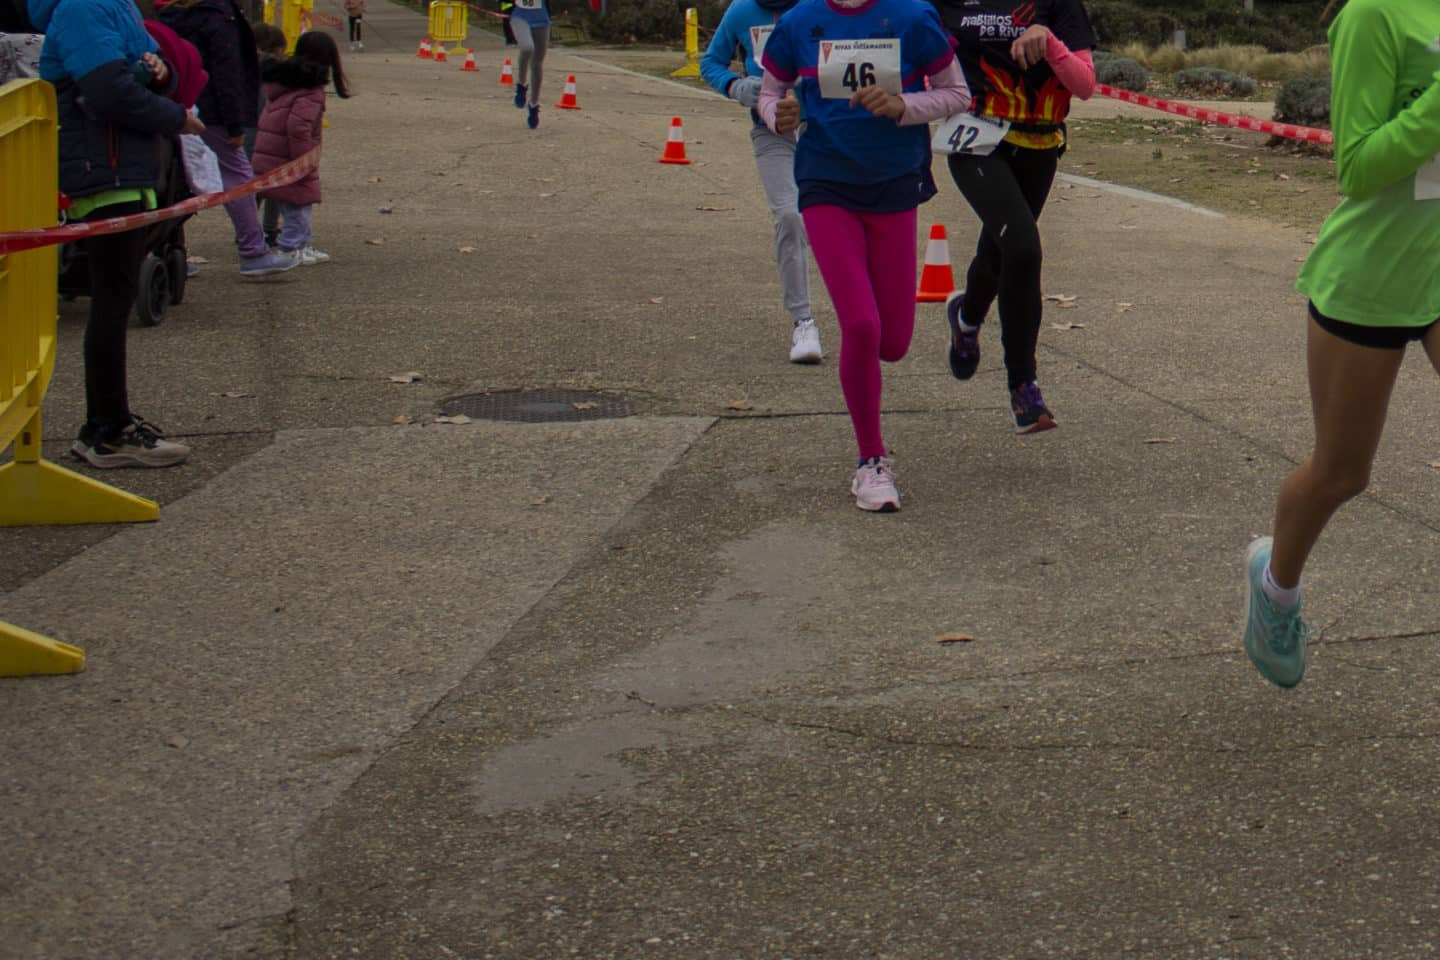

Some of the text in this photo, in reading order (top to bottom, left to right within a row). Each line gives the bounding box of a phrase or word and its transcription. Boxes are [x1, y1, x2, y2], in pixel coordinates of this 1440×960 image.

[999, 25, 1027, 38] Riva
[842, 62, 877, 92] 46
[948, 124, 979, 153] 42
